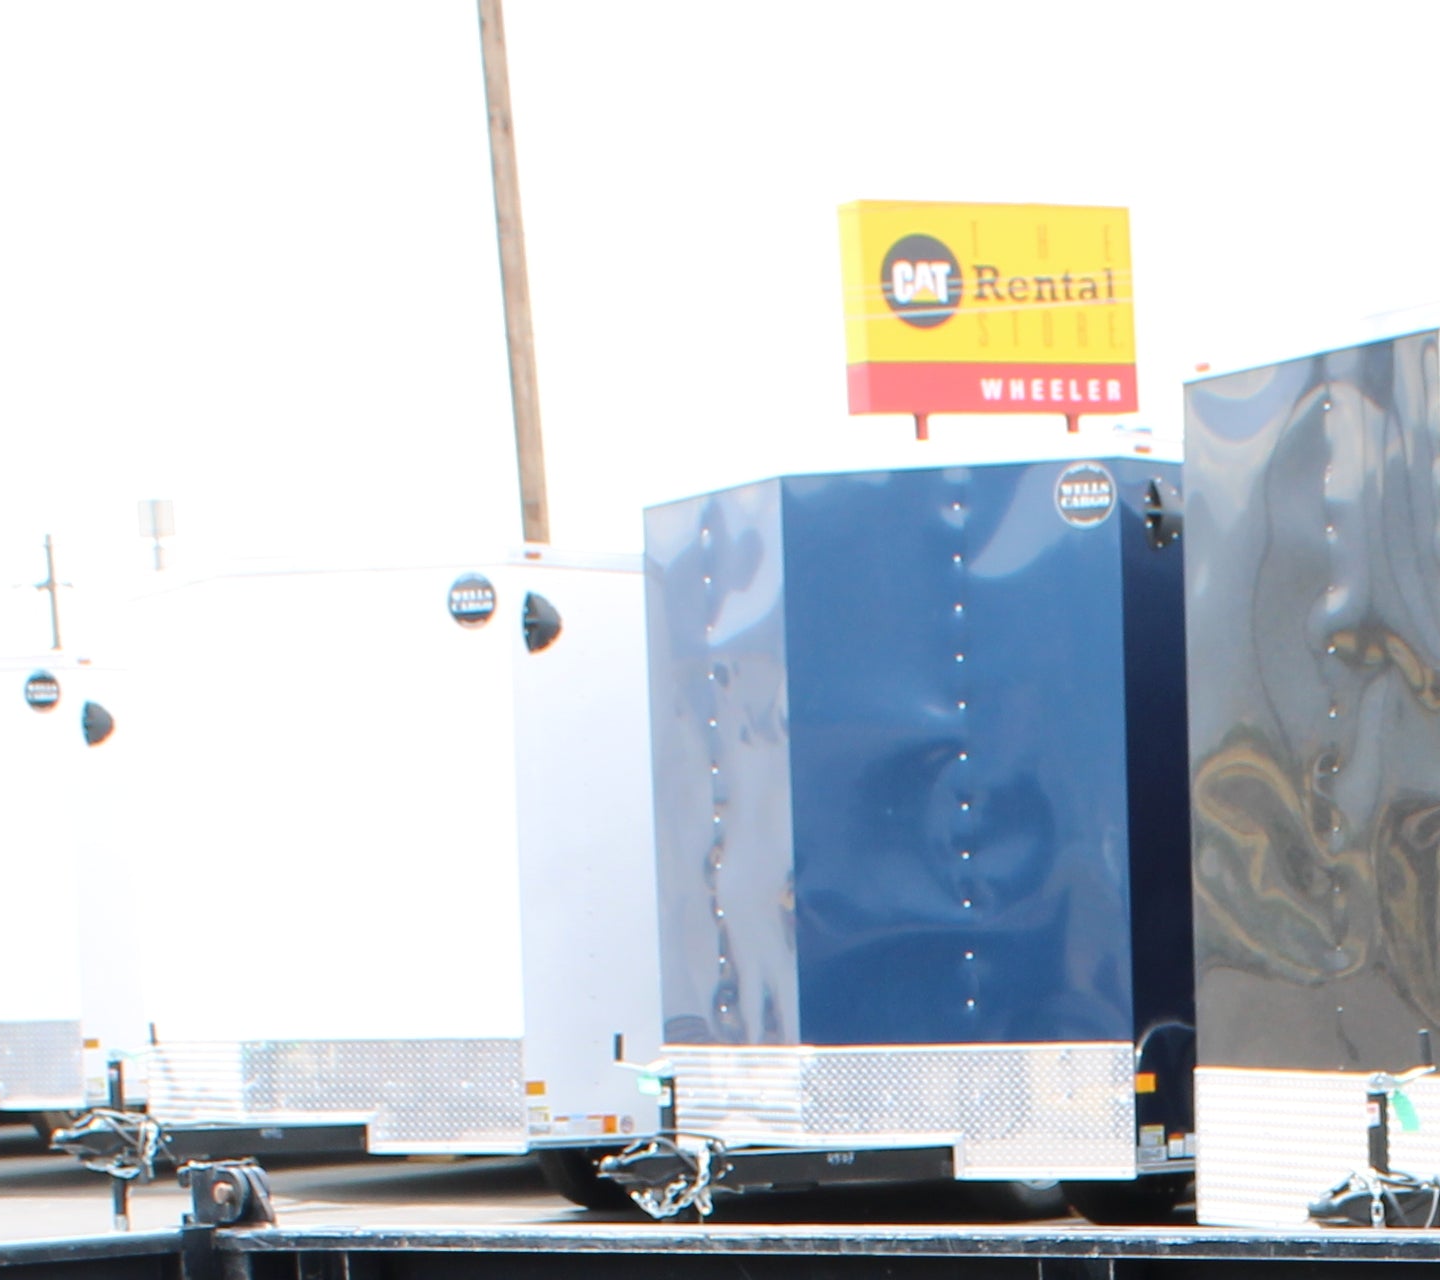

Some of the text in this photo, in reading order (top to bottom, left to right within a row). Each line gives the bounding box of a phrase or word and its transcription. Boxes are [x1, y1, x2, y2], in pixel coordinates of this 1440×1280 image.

[891, 259, 953, 303] CAT
[971, 264, 1117, 304] Rental
[981, 377, 1122, 401] WHEELER
